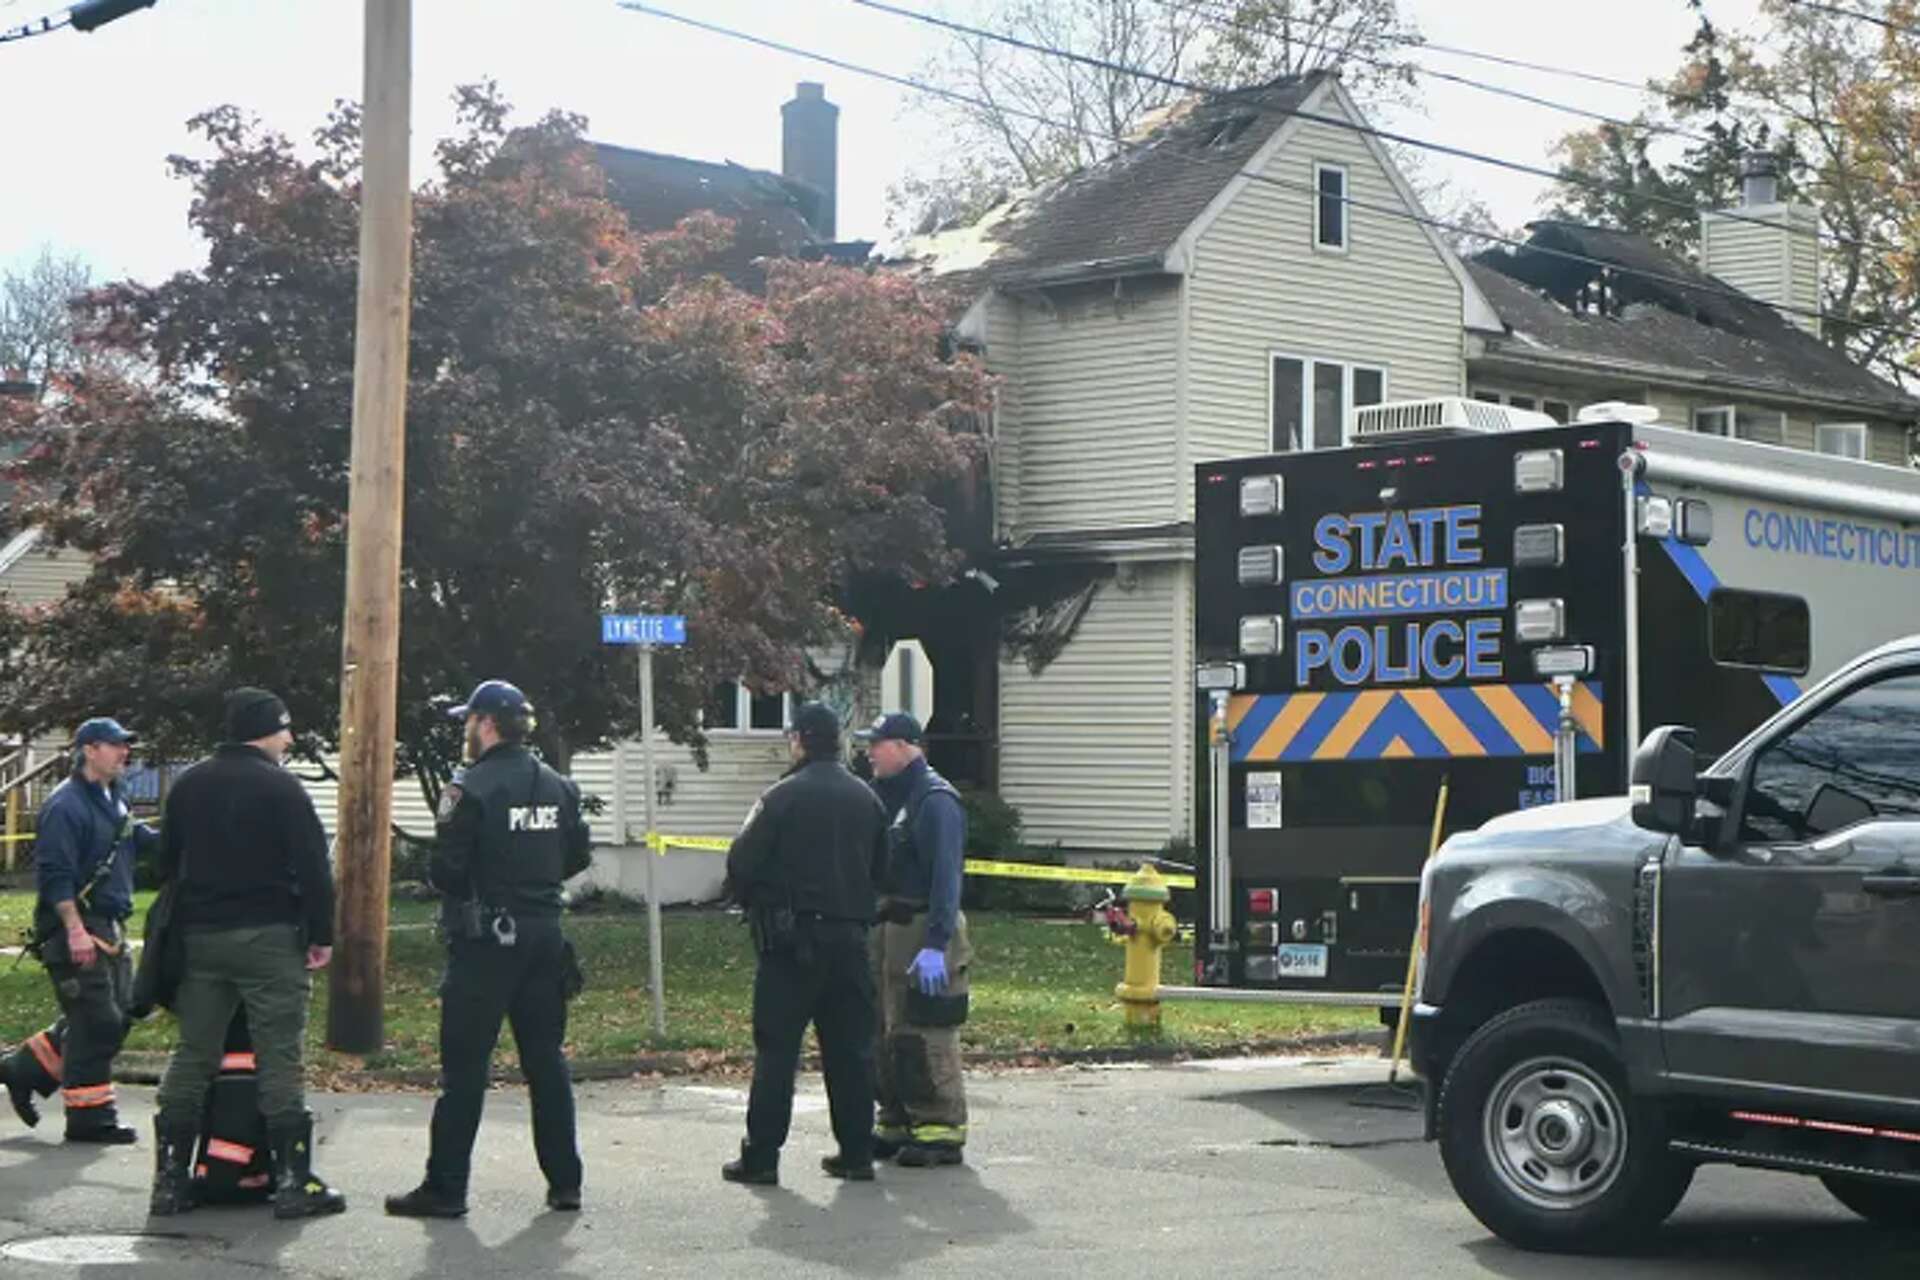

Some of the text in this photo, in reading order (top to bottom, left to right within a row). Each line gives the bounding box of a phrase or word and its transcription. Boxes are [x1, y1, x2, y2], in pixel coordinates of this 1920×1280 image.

[1313, 505, 1482, 574] STATE
[1296, 575, 1501, 613] CONNECTICUT
[1297, 617, 1503, 687] POLICE
[509, 806, 559, 831] POLICE
